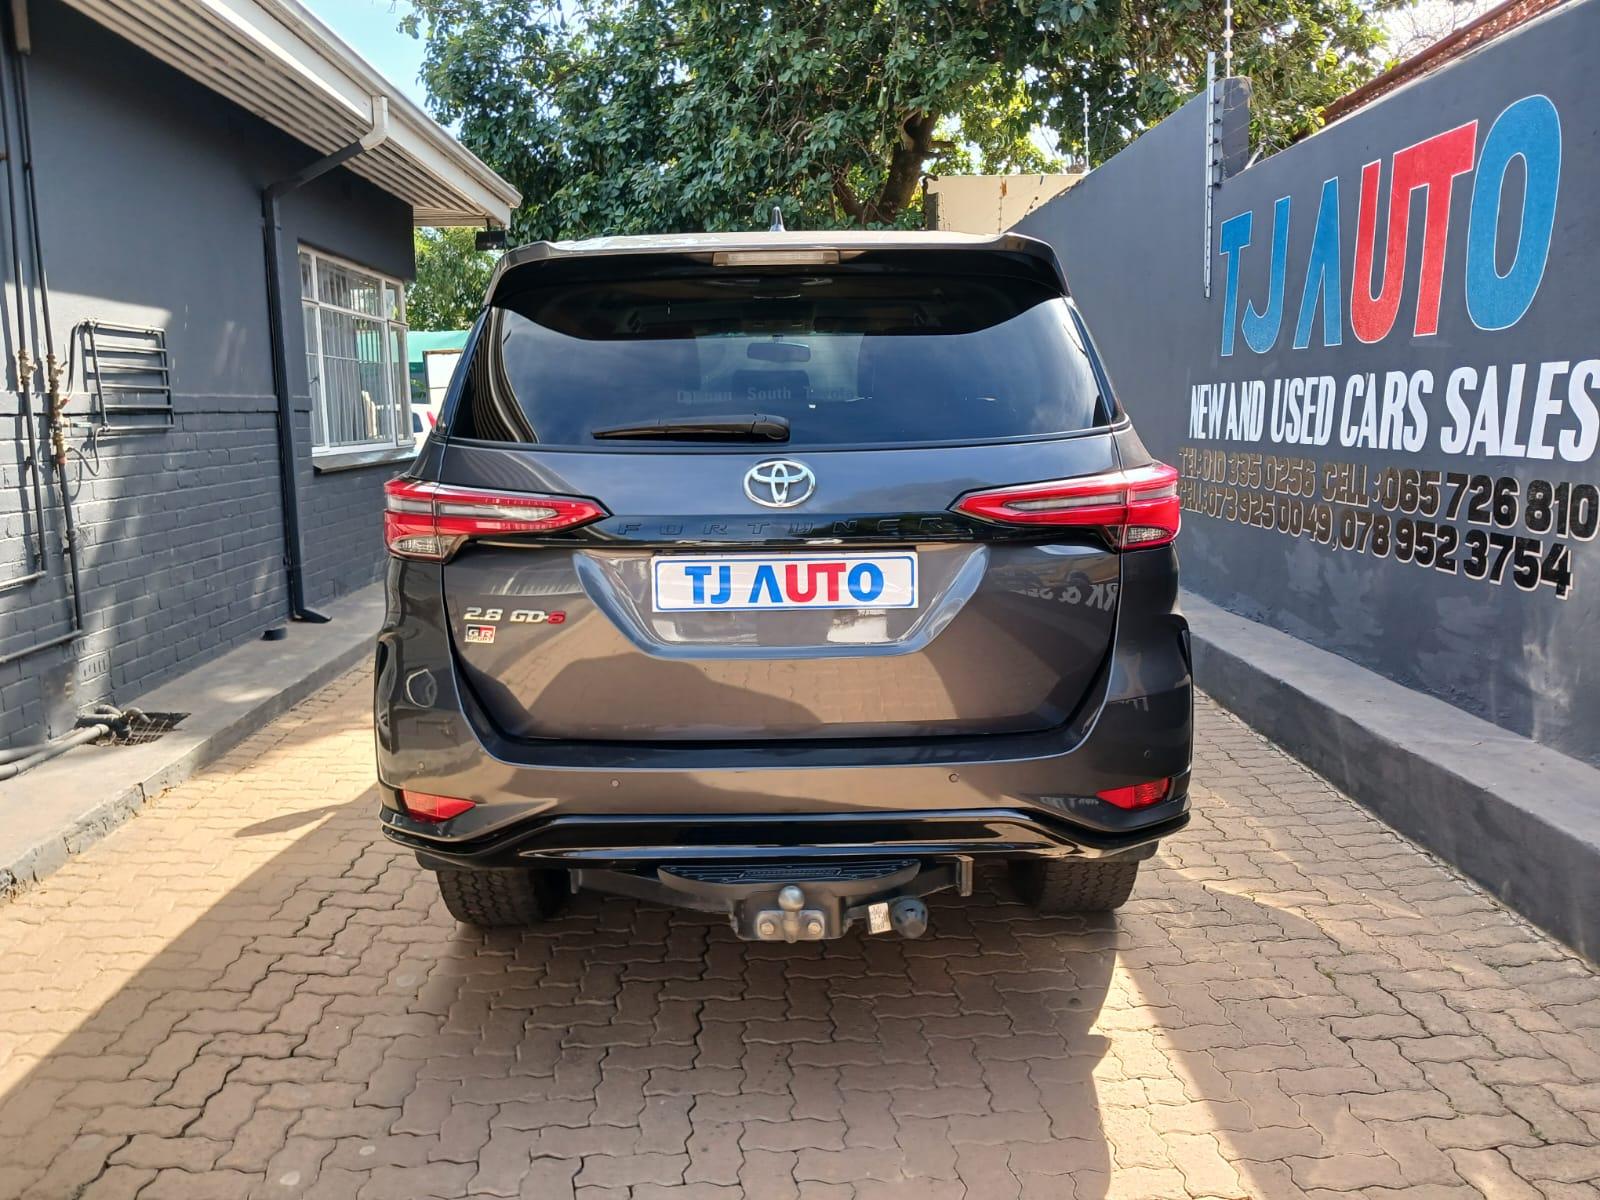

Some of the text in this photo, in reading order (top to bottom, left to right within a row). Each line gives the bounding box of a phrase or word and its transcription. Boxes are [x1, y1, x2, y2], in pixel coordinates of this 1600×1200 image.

[1219, 94, 1562, 356] TJ AUTO
[747, 387, 791, 401] South
[1189, 359, 1600, 462] NEW AND USED CARS SALES
[616, 516, 946, 537] FORTUNER
[1228, 452, 1263, 490] 335
[1264, 455, 1317, 498] 0256
[1446, 472, 1520, 529] 726
[1525, 479, 1600, 542] 810
[1239, 491, 1276, 530] 925
[1395, 518, 1459, 575] 952
[1463, 529, 1573, 600] 3754
[464, 607, 567, 624] 2.8 GD-6
[684, 562, 885, 605] TJ AUTO
